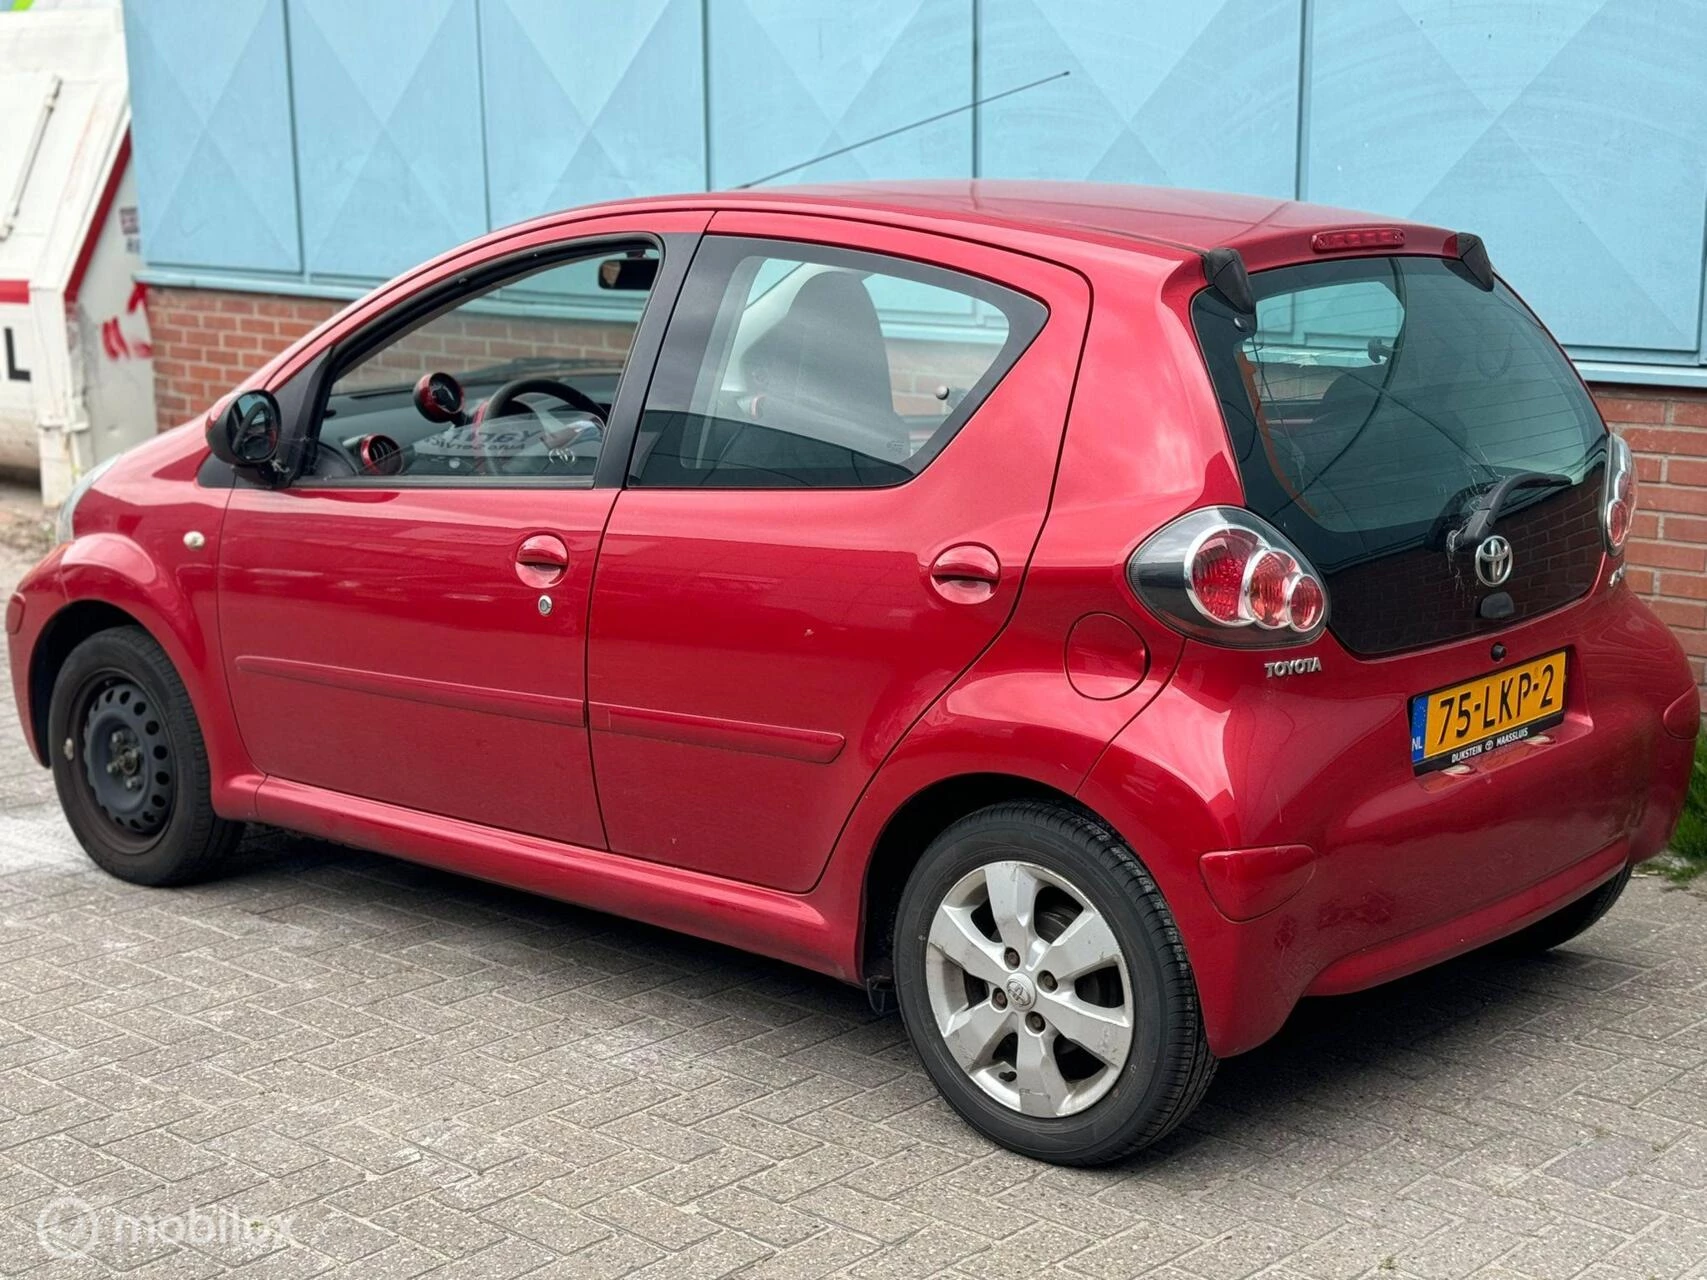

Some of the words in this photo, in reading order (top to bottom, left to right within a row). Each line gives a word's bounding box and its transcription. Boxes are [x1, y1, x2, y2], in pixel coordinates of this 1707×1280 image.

[1264, 656, 1322, 678] TOYOTA
[1437, 664, 1555, 745] 75-LKP-2
[1411, 737, 1423, 750] NL
[1451, 744, 1483, 763] DIJKSTEIN
[1496, 727, 1529, 747] MAASSLUIS
